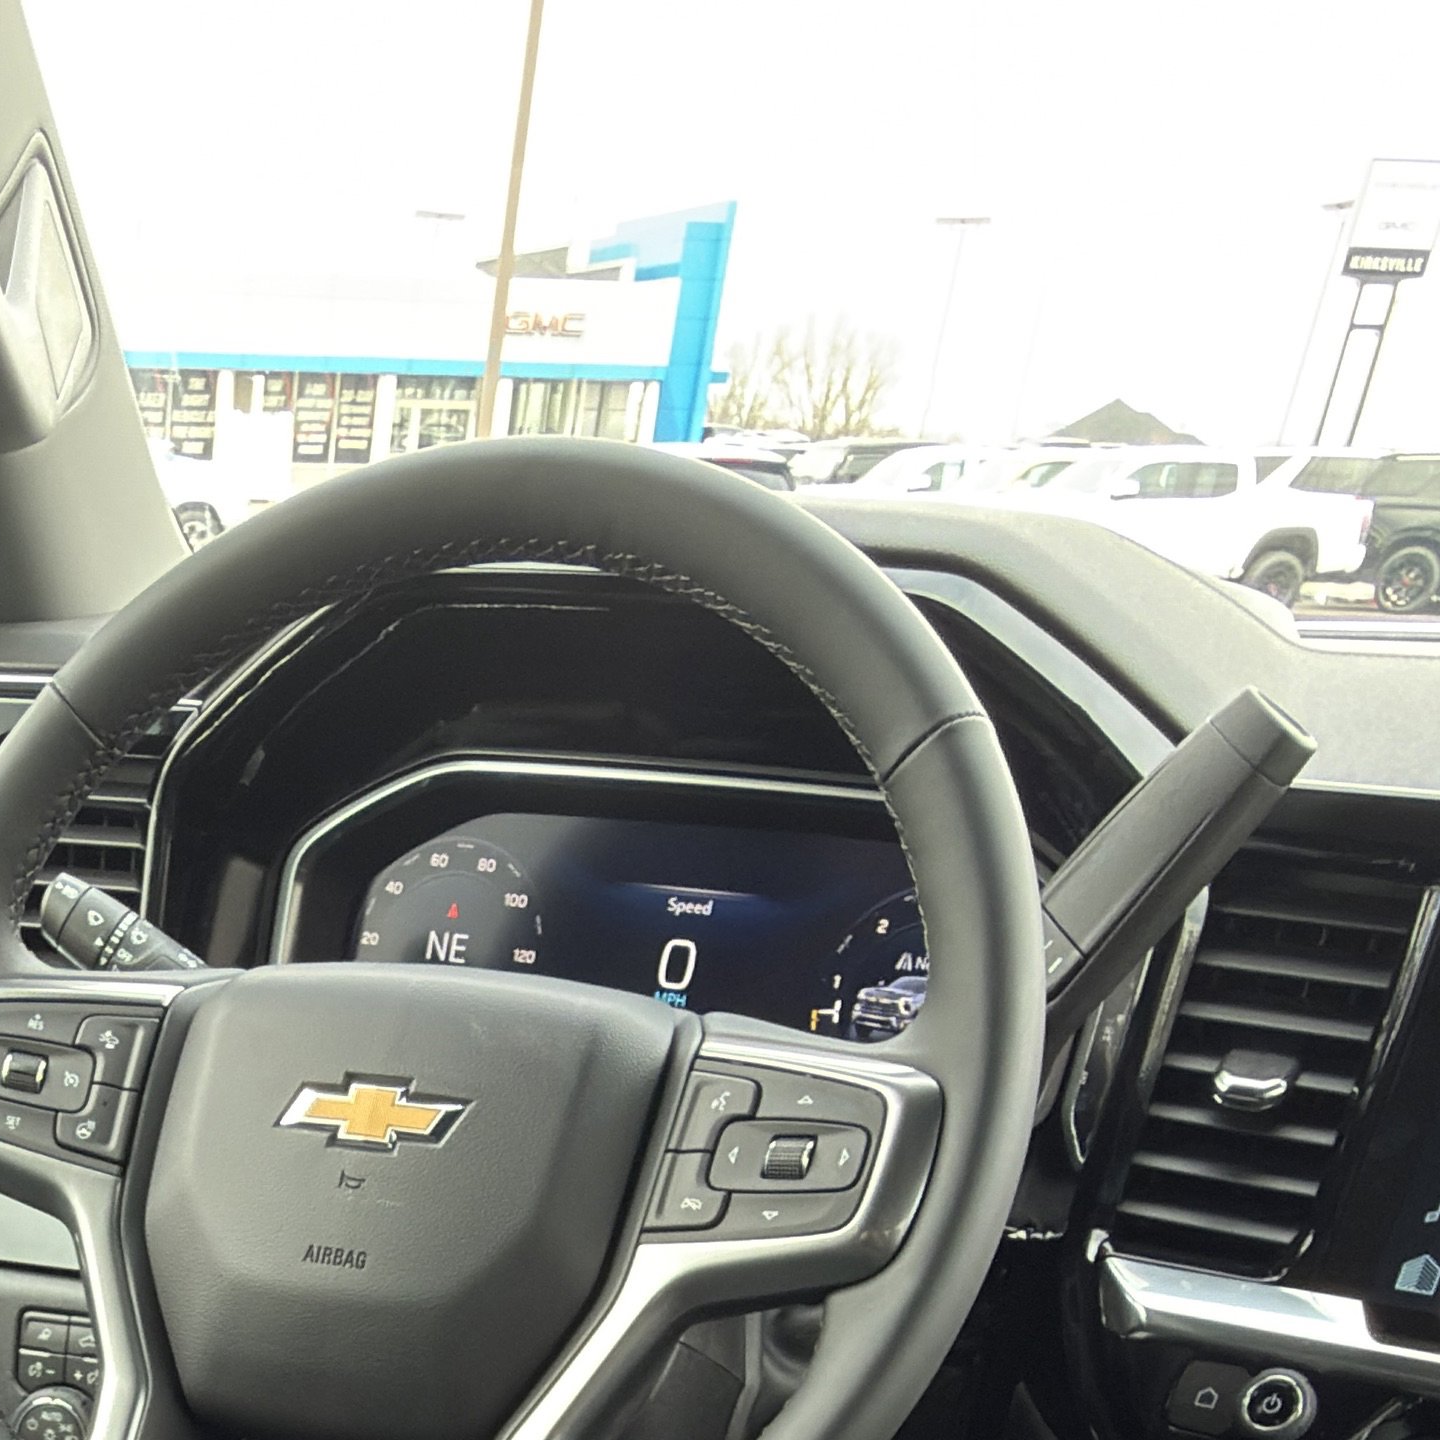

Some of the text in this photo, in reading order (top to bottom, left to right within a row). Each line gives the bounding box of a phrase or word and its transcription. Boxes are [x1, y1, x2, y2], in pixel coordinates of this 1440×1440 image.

[504, 311, 586, 337] GMC
[430, 853, 449, 868] 60
[477, 858, 496, 872] 80
[384, 881, 404, 895] 40
[504, 893, 528, 908] 100
[666, 896, 714, 916] Speed
[876, 919, 890, 934] 2
[361, 931, 379, 945] 20
[425, 930, 469, 964] NE
[512, 948, 536, 964] 120
[658, 939, 697, 990] 0
[833, 974, 842, 989] 1
[301, 1244, 368, 1270] AIRBAG
